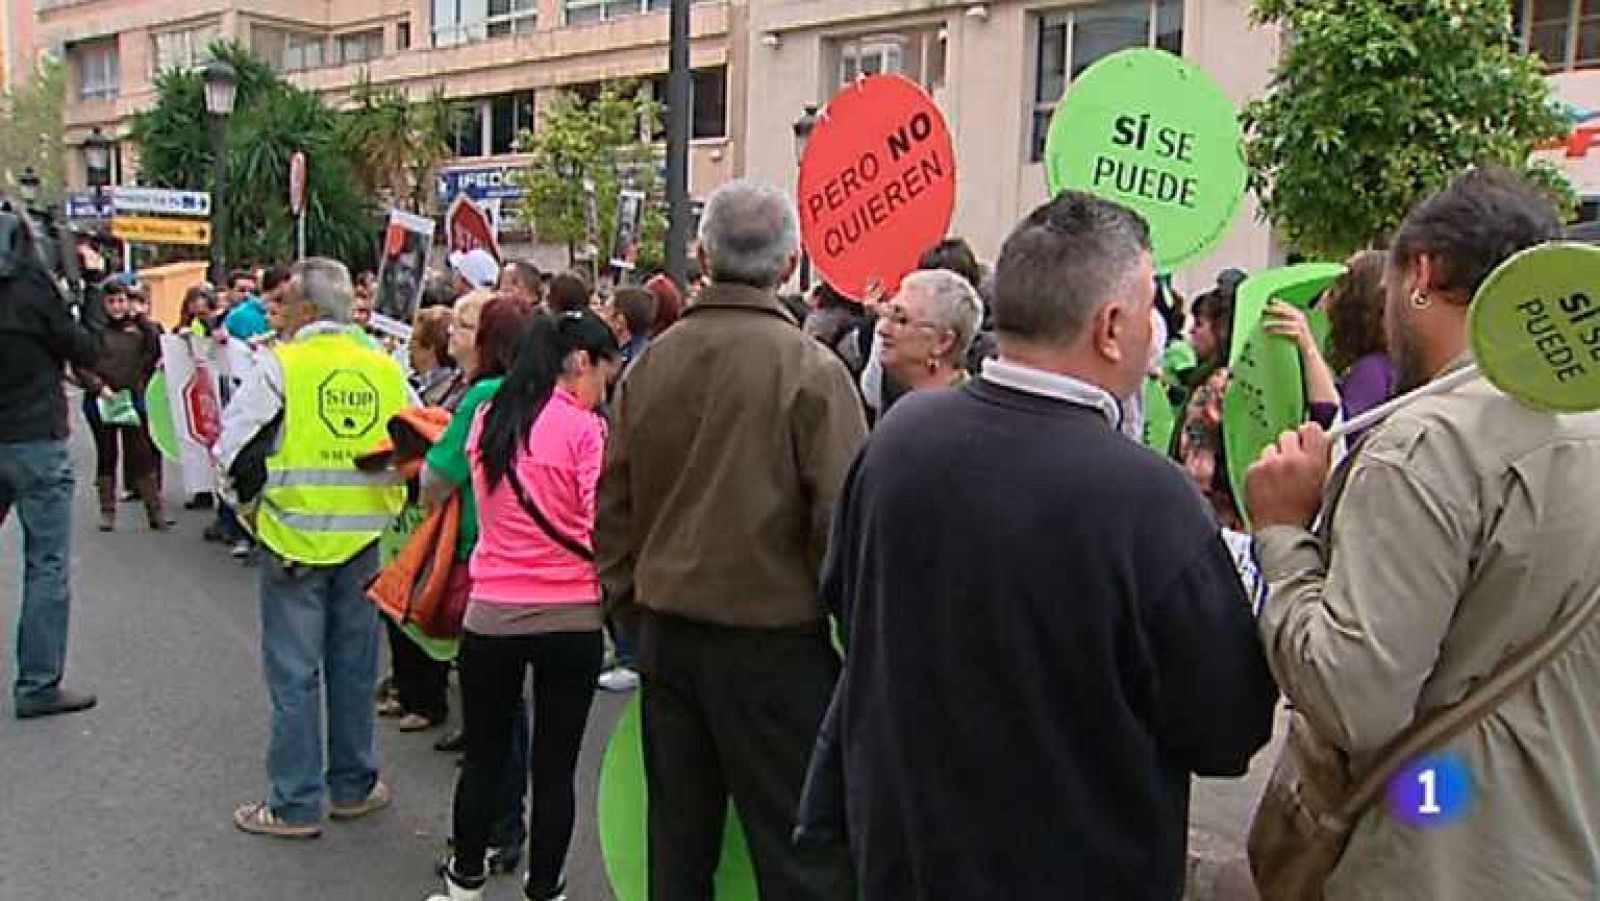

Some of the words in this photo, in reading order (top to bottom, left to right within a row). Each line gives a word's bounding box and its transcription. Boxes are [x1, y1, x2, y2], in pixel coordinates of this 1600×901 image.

[808, 151, 879, 223] PERO
[887, 112, 931, 162] NO
[1111, 113, 1151, 151] SÍ
[1155, 126, 1196, 163] SE
[824, 149, 943, 258] QUIEREN
[1093, 155, 1198, 209] PUEDE
[1516, 297, 1585, 382] PUEDE
[326, 389, 372, 406] STOP
